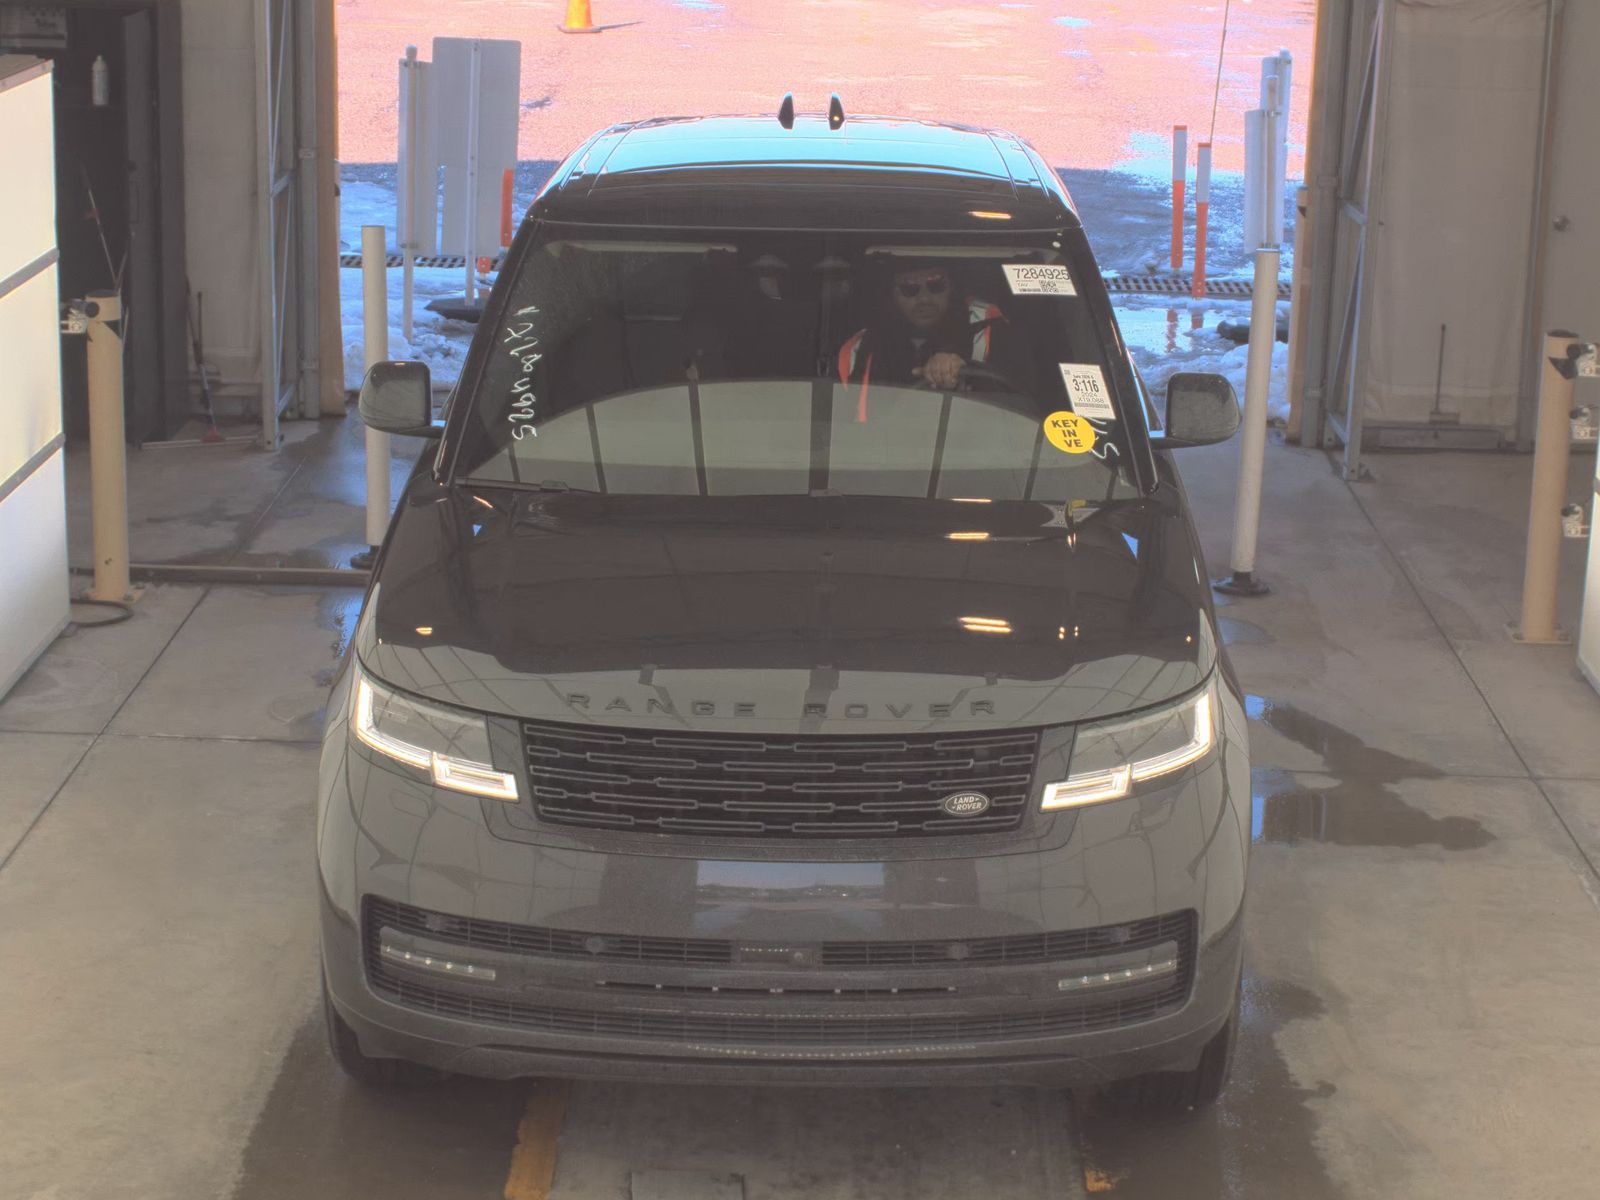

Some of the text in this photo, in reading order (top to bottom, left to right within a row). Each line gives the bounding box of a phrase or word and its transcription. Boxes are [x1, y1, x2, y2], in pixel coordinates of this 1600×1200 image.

[1013, 268, 1070, 280] 7284925
[1051, 419, 1078, 428] KEY
[1062, 429, 1077, 438] IN
[1064, 438, 1083, 448] VE
[567, 693, 996, 719] RANGE ROVER
[953, 796, 975, 805] LAND
[956, 802, 982, 811] ROVER
